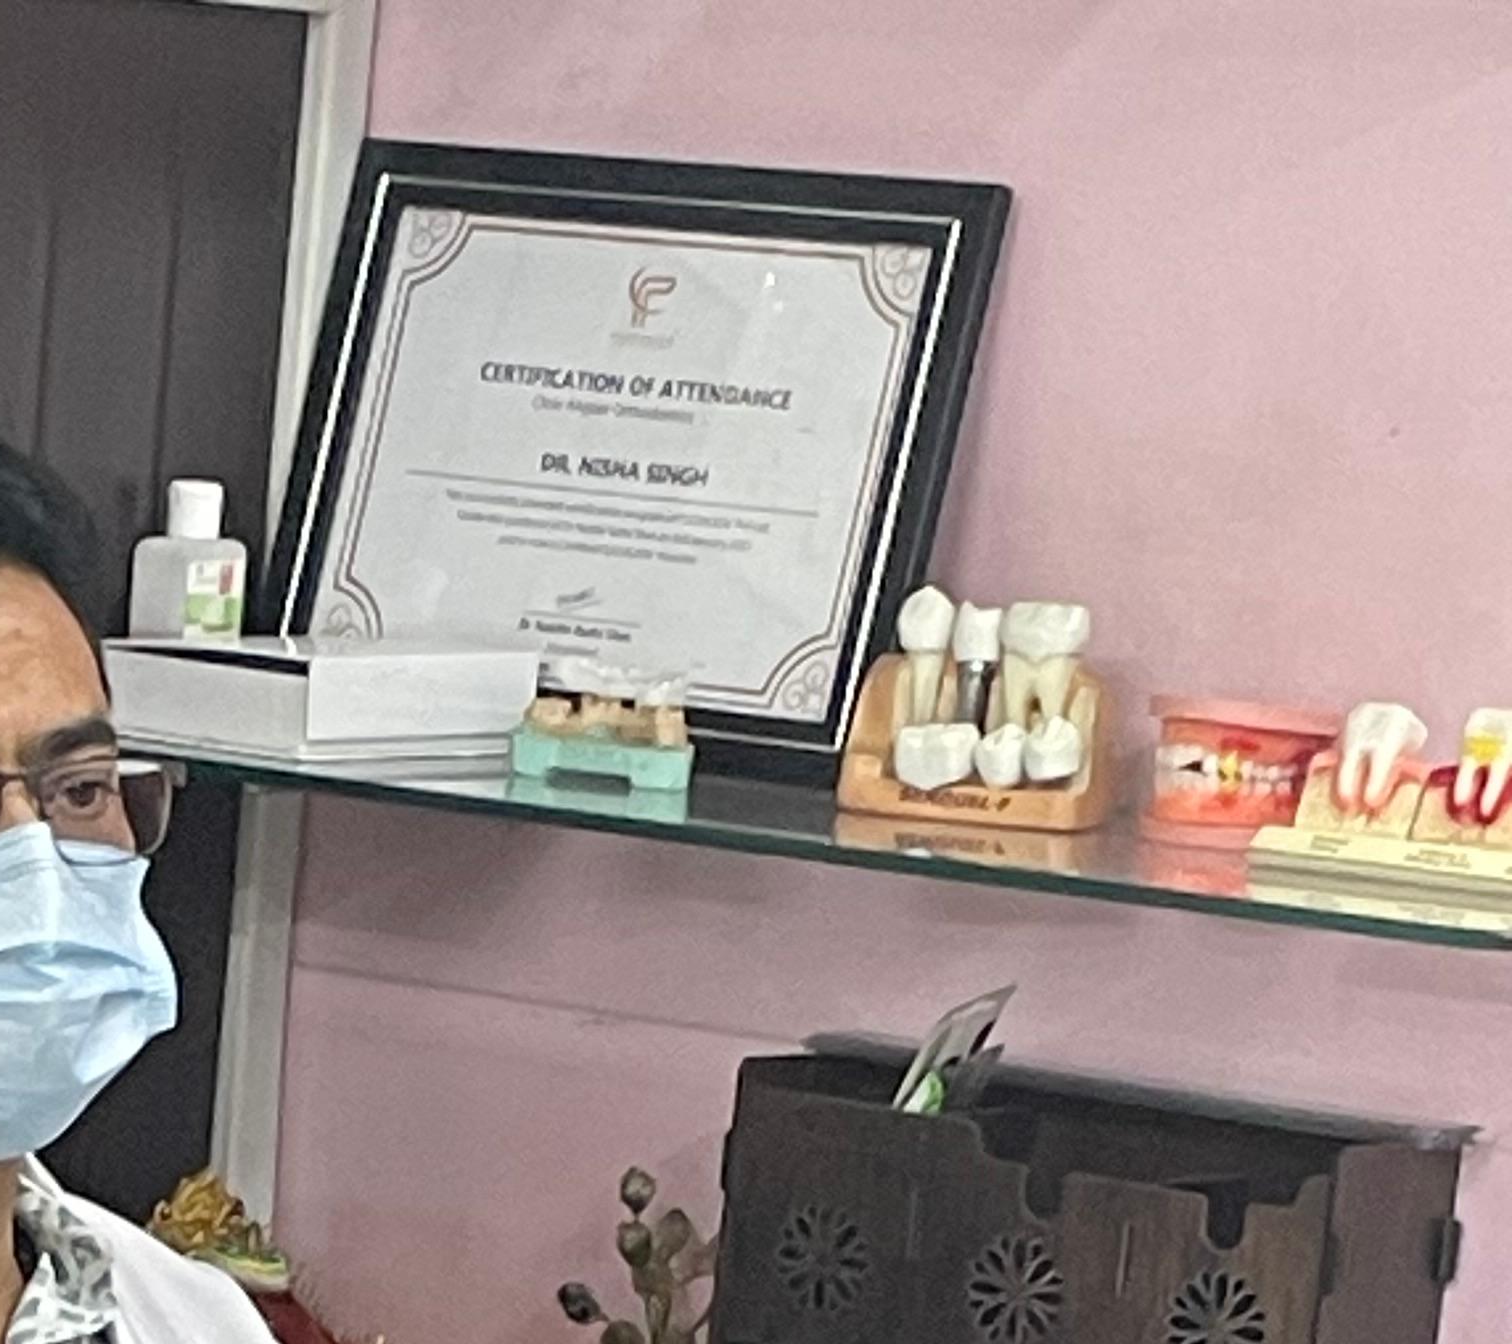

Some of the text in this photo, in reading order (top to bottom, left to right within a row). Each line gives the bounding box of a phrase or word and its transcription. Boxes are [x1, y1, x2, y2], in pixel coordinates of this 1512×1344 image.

[481, 361, 793, 411] CERTIFICATION OF ATTENDANCE
